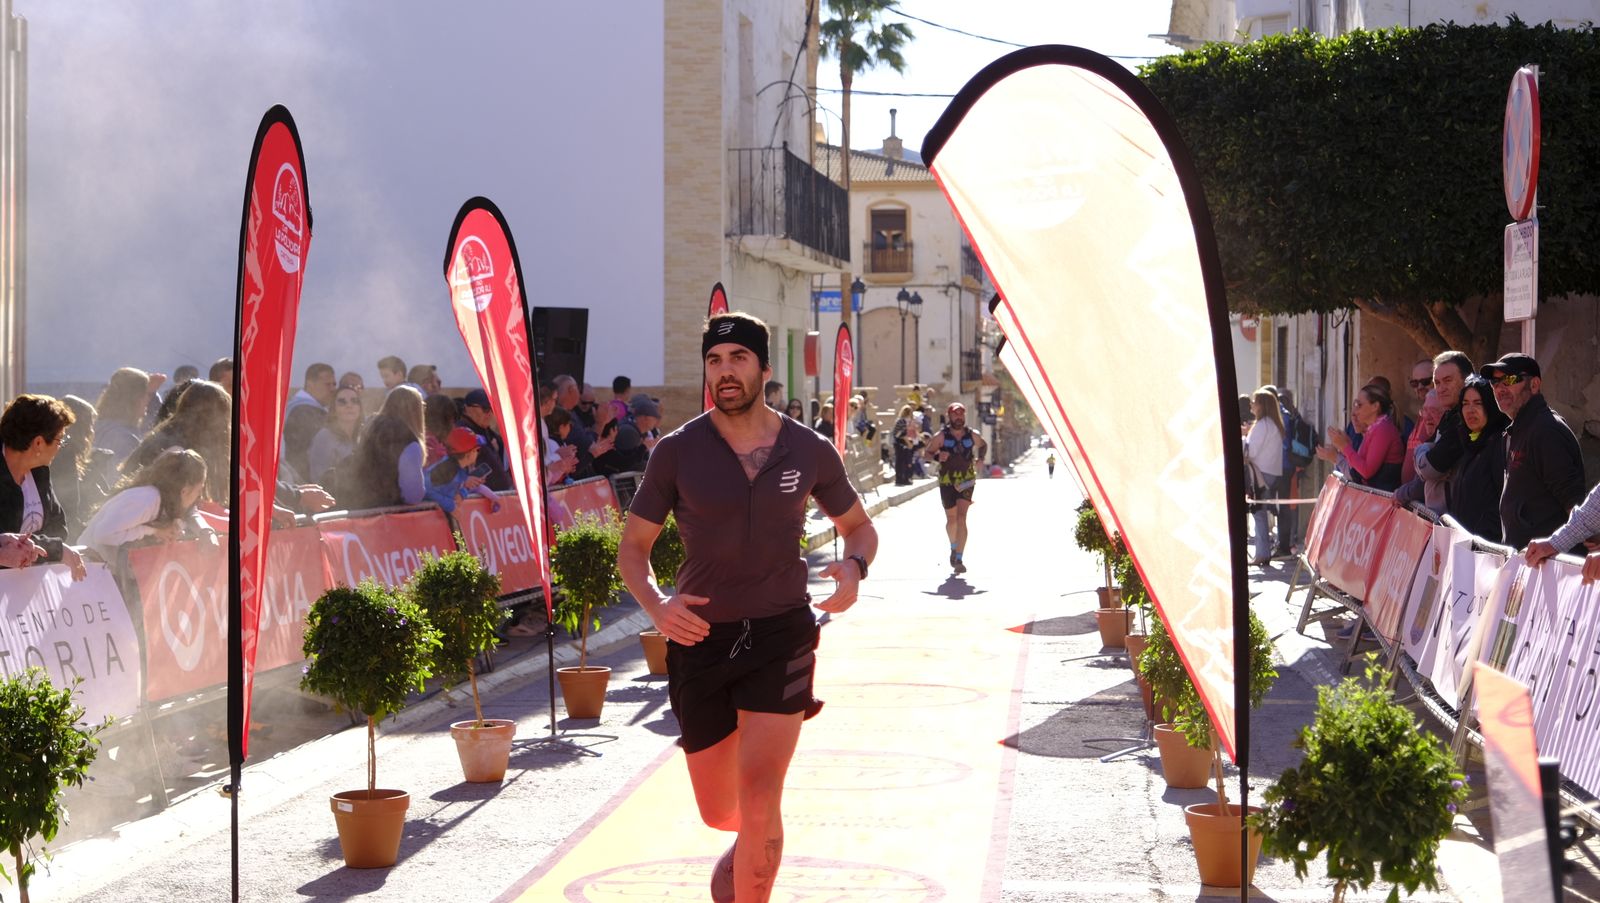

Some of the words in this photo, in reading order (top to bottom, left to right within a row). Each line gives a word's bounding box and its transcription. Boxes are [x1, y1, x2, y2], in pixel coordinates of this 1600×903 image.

[491, 524, 536, 566] VEOL
[0, 607, 73, 639] IENTO
[82, 601, 111, 625] DE
